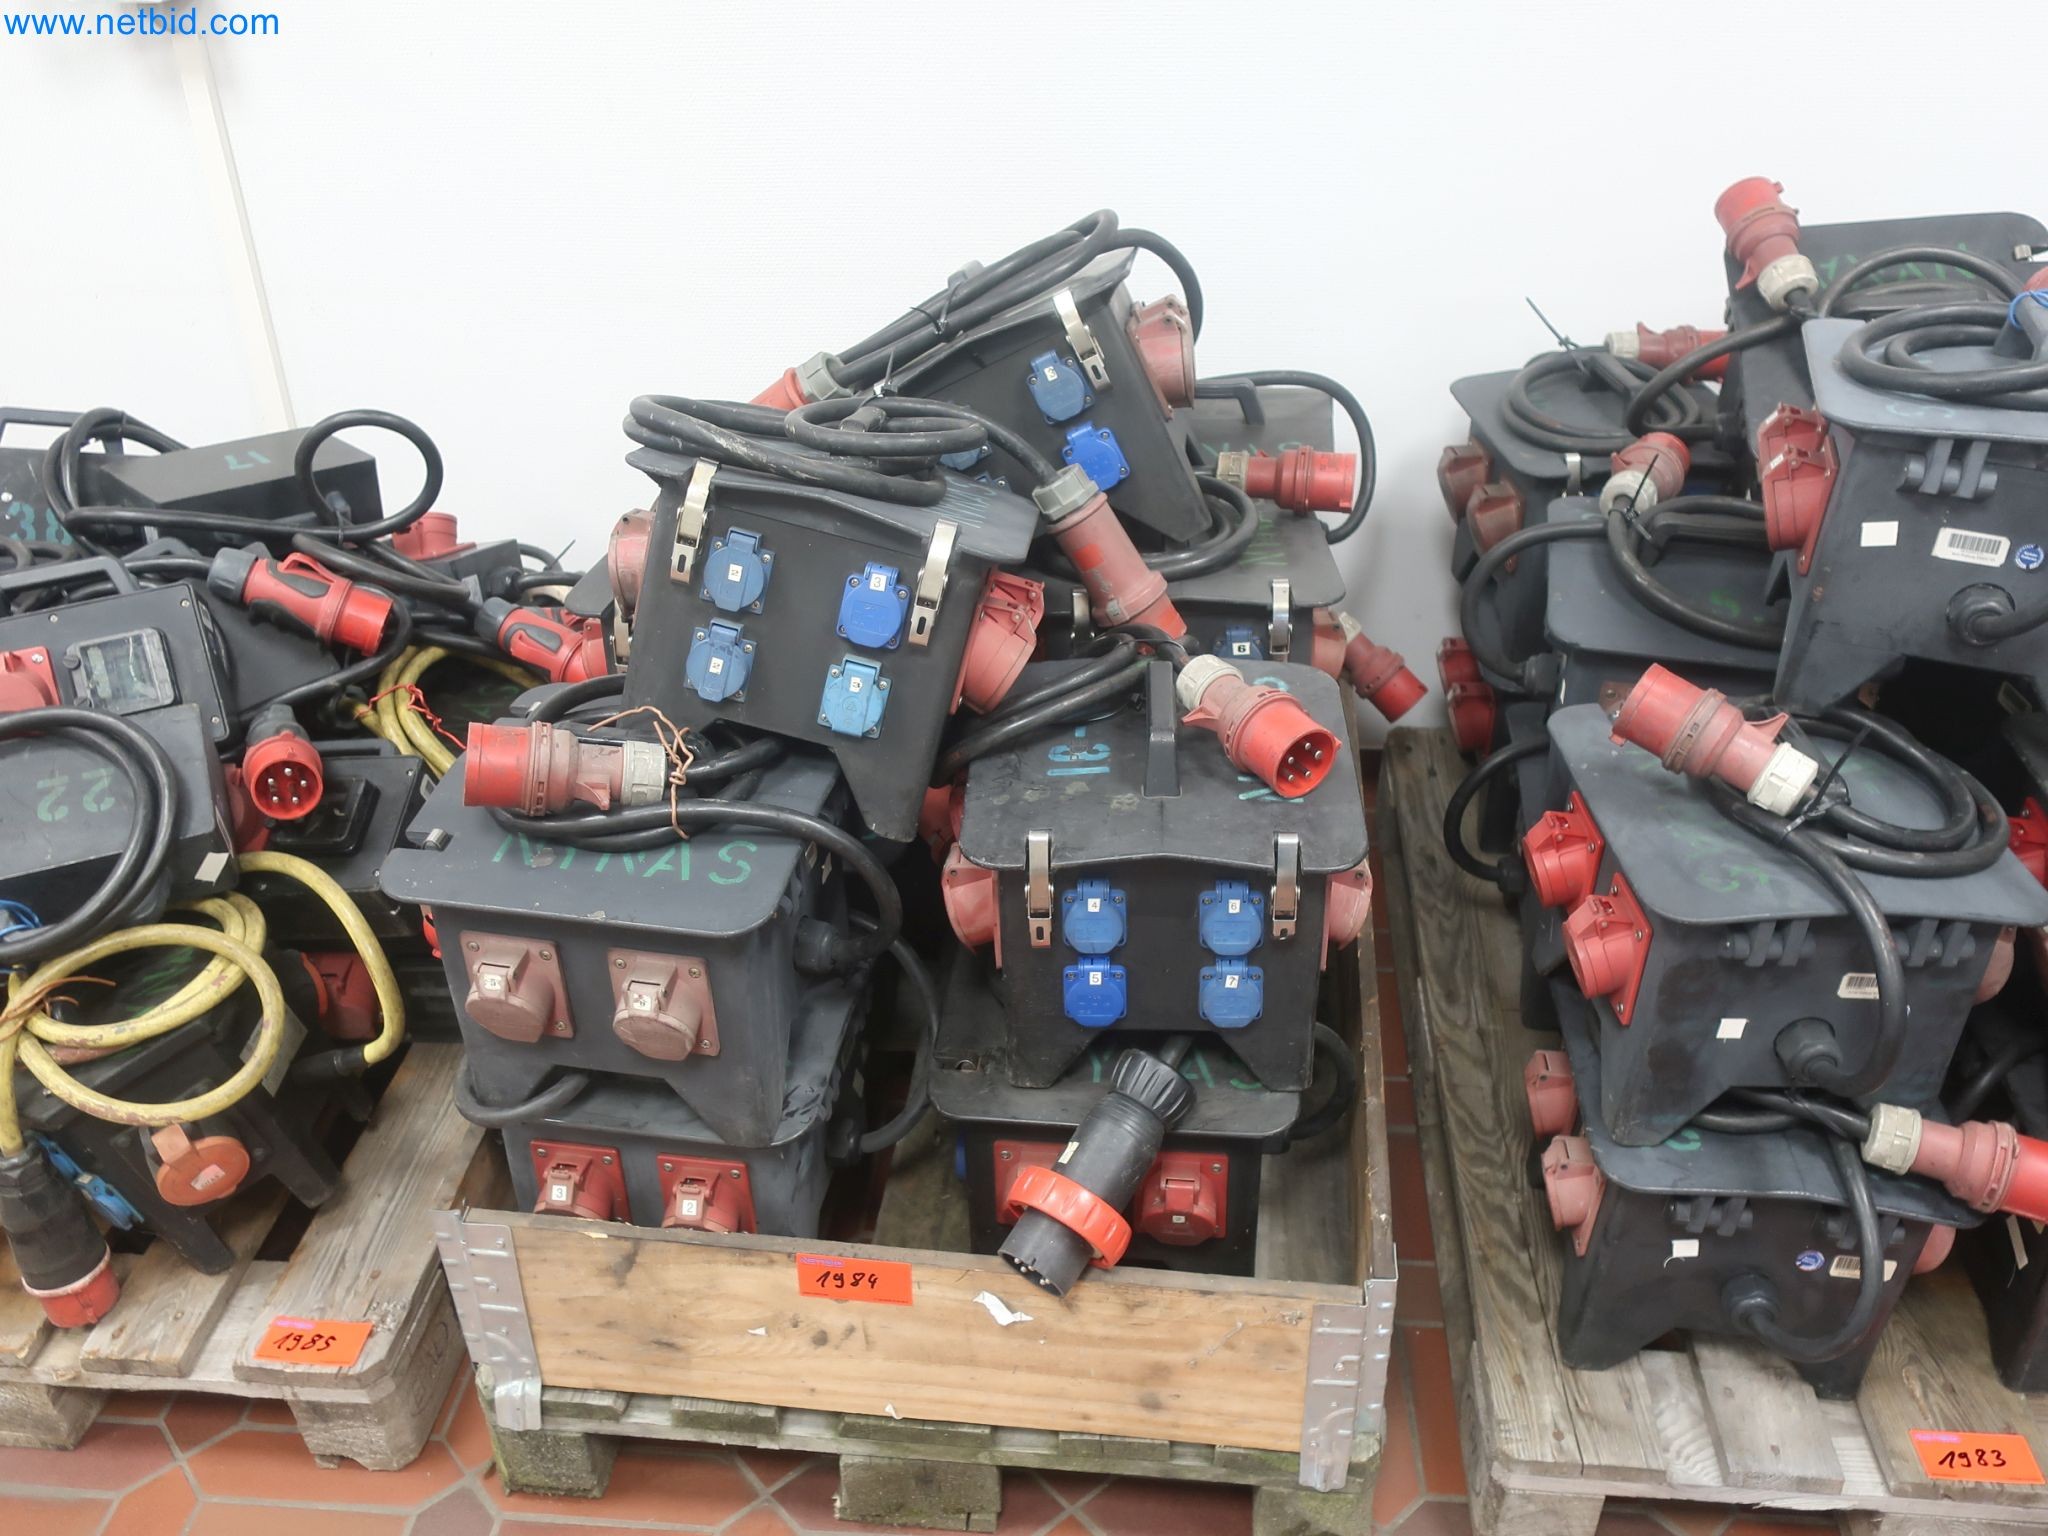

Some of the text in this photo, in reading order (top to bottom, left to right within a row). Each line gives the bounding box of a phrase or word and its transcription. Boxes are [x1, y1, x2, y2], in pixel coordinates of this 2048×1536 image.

[873, 576, 882, 588] 3
[36, 767, 116, 822] 22
[491, 828, 758, 885] NAS
[1091, 973, 1100, 983] 5
[555, 1187, 564, 1199] 3
[686, 1201, 694, 1213] 2
[815, 1270, 879, 1289] 1984
[272, 1332, 337, 1352] 1985
[1938, 1448, 2007, 1469] 1983
